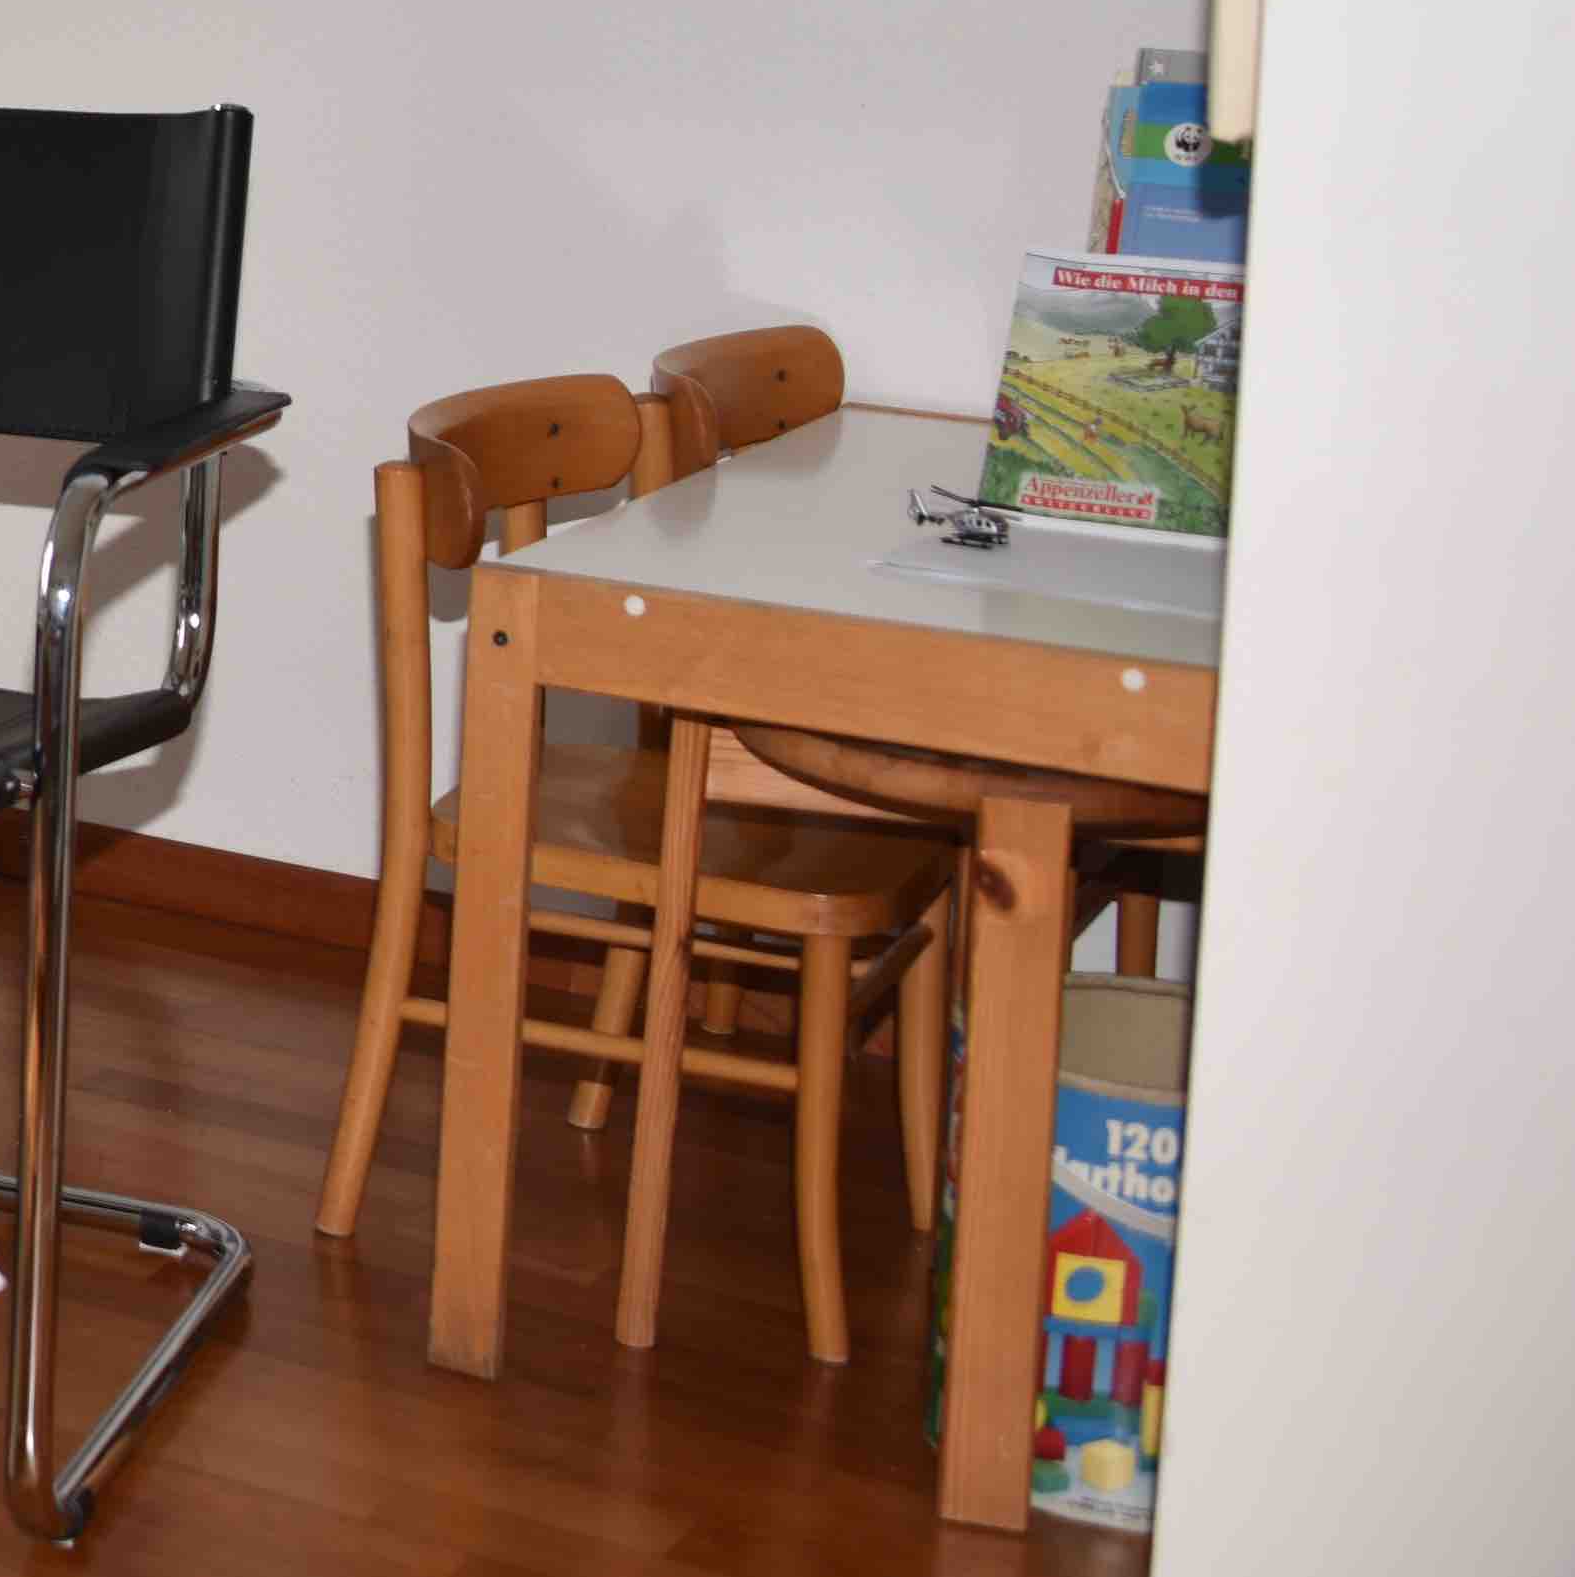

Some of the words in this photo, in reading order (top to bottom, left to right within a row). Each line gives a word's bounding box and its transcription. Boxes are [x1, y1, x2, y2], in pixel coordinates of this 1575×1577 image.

[1057, 269, 1092, 287] Wie
[1094, 274, 1124, 290] die
[1125, 276, 1178, 295] Milch
[1181, 283, 1201, 296] in
[1205, 282, 1238, 298] den
[1025, 474, 1139, 505] Appenzeller
[1105, 1119, 1178, 1165] 120
